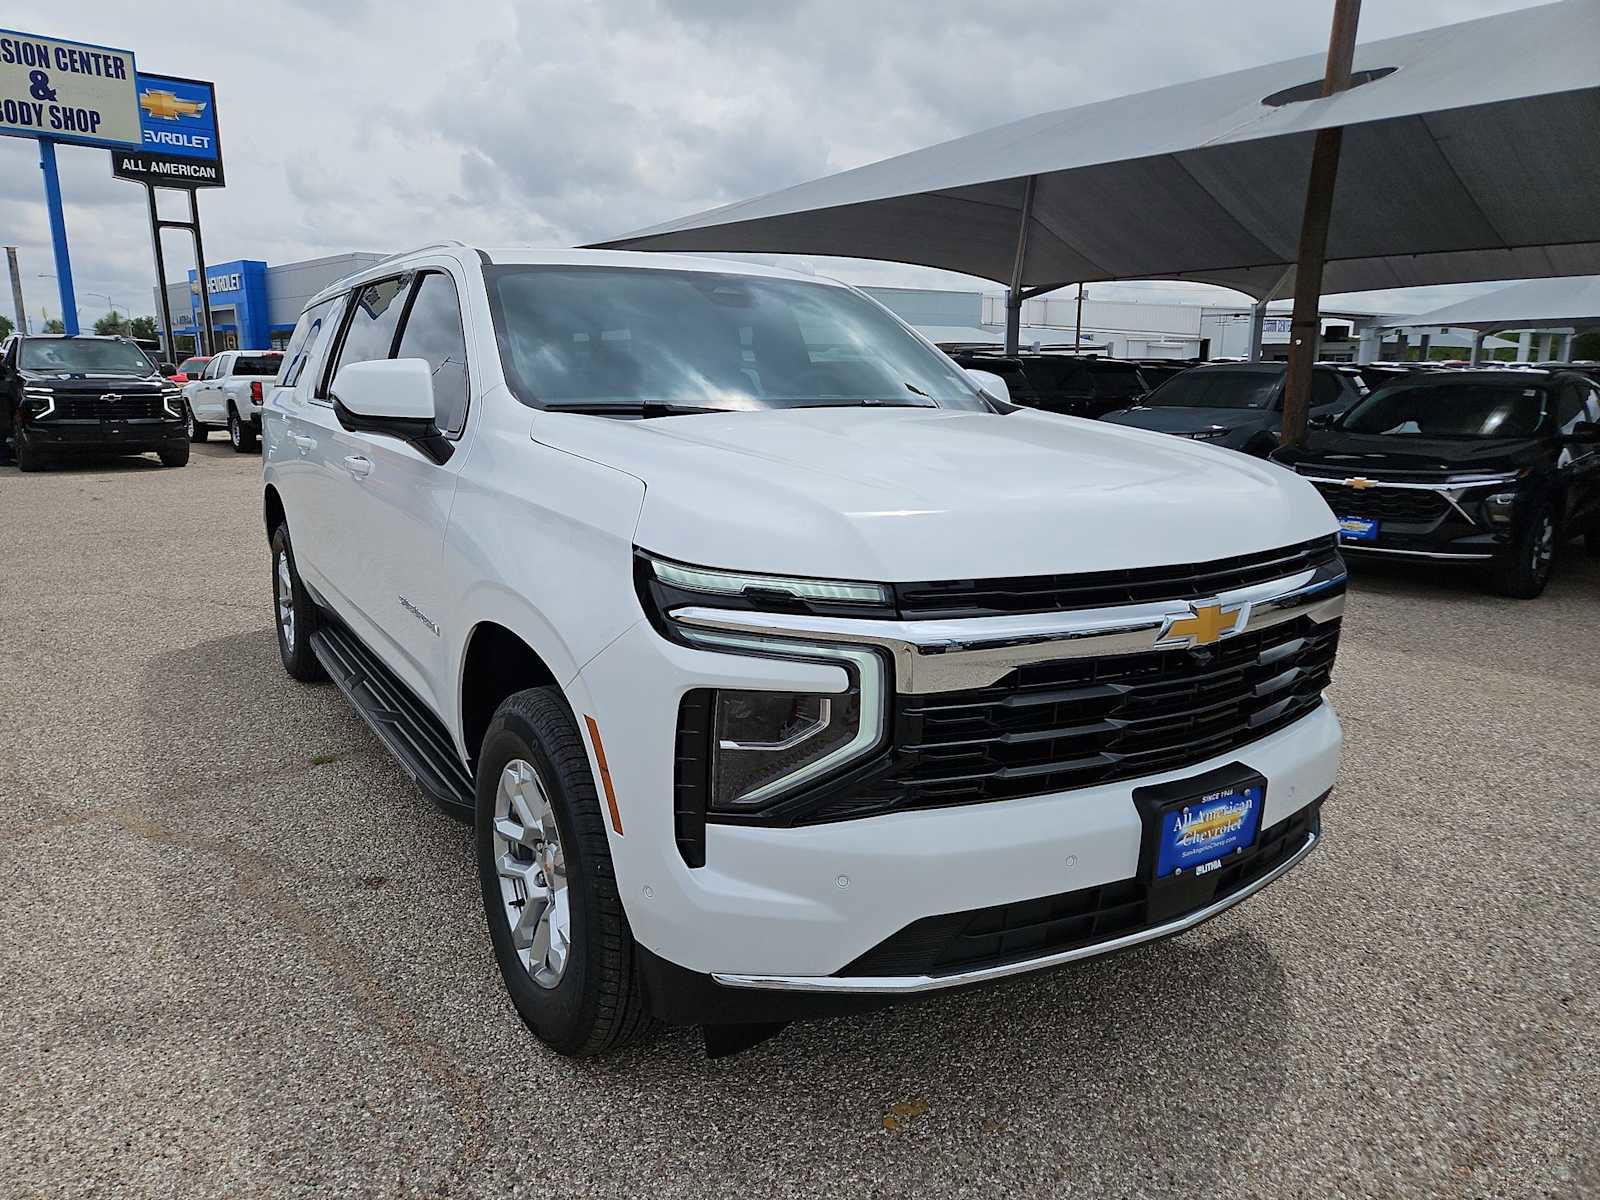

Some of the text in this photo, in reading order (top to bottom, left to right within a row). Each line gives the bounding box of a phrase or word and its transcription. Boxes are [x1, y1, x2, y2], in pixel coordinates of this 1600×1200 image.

[0, 38, 127, 80] SION CENTER
[29, 69, 57, 102] &
[48, 104, 101, 134] SHOP
[143, 129, 211, 149] EVROLET
[122, 158, 217, 179] ALL AMERICAN
[207, 272, 241, 295] HEVROLET
[1173, 799, 1253, 832] All American
[1183, 818, 1242, 847] Chevrolet
